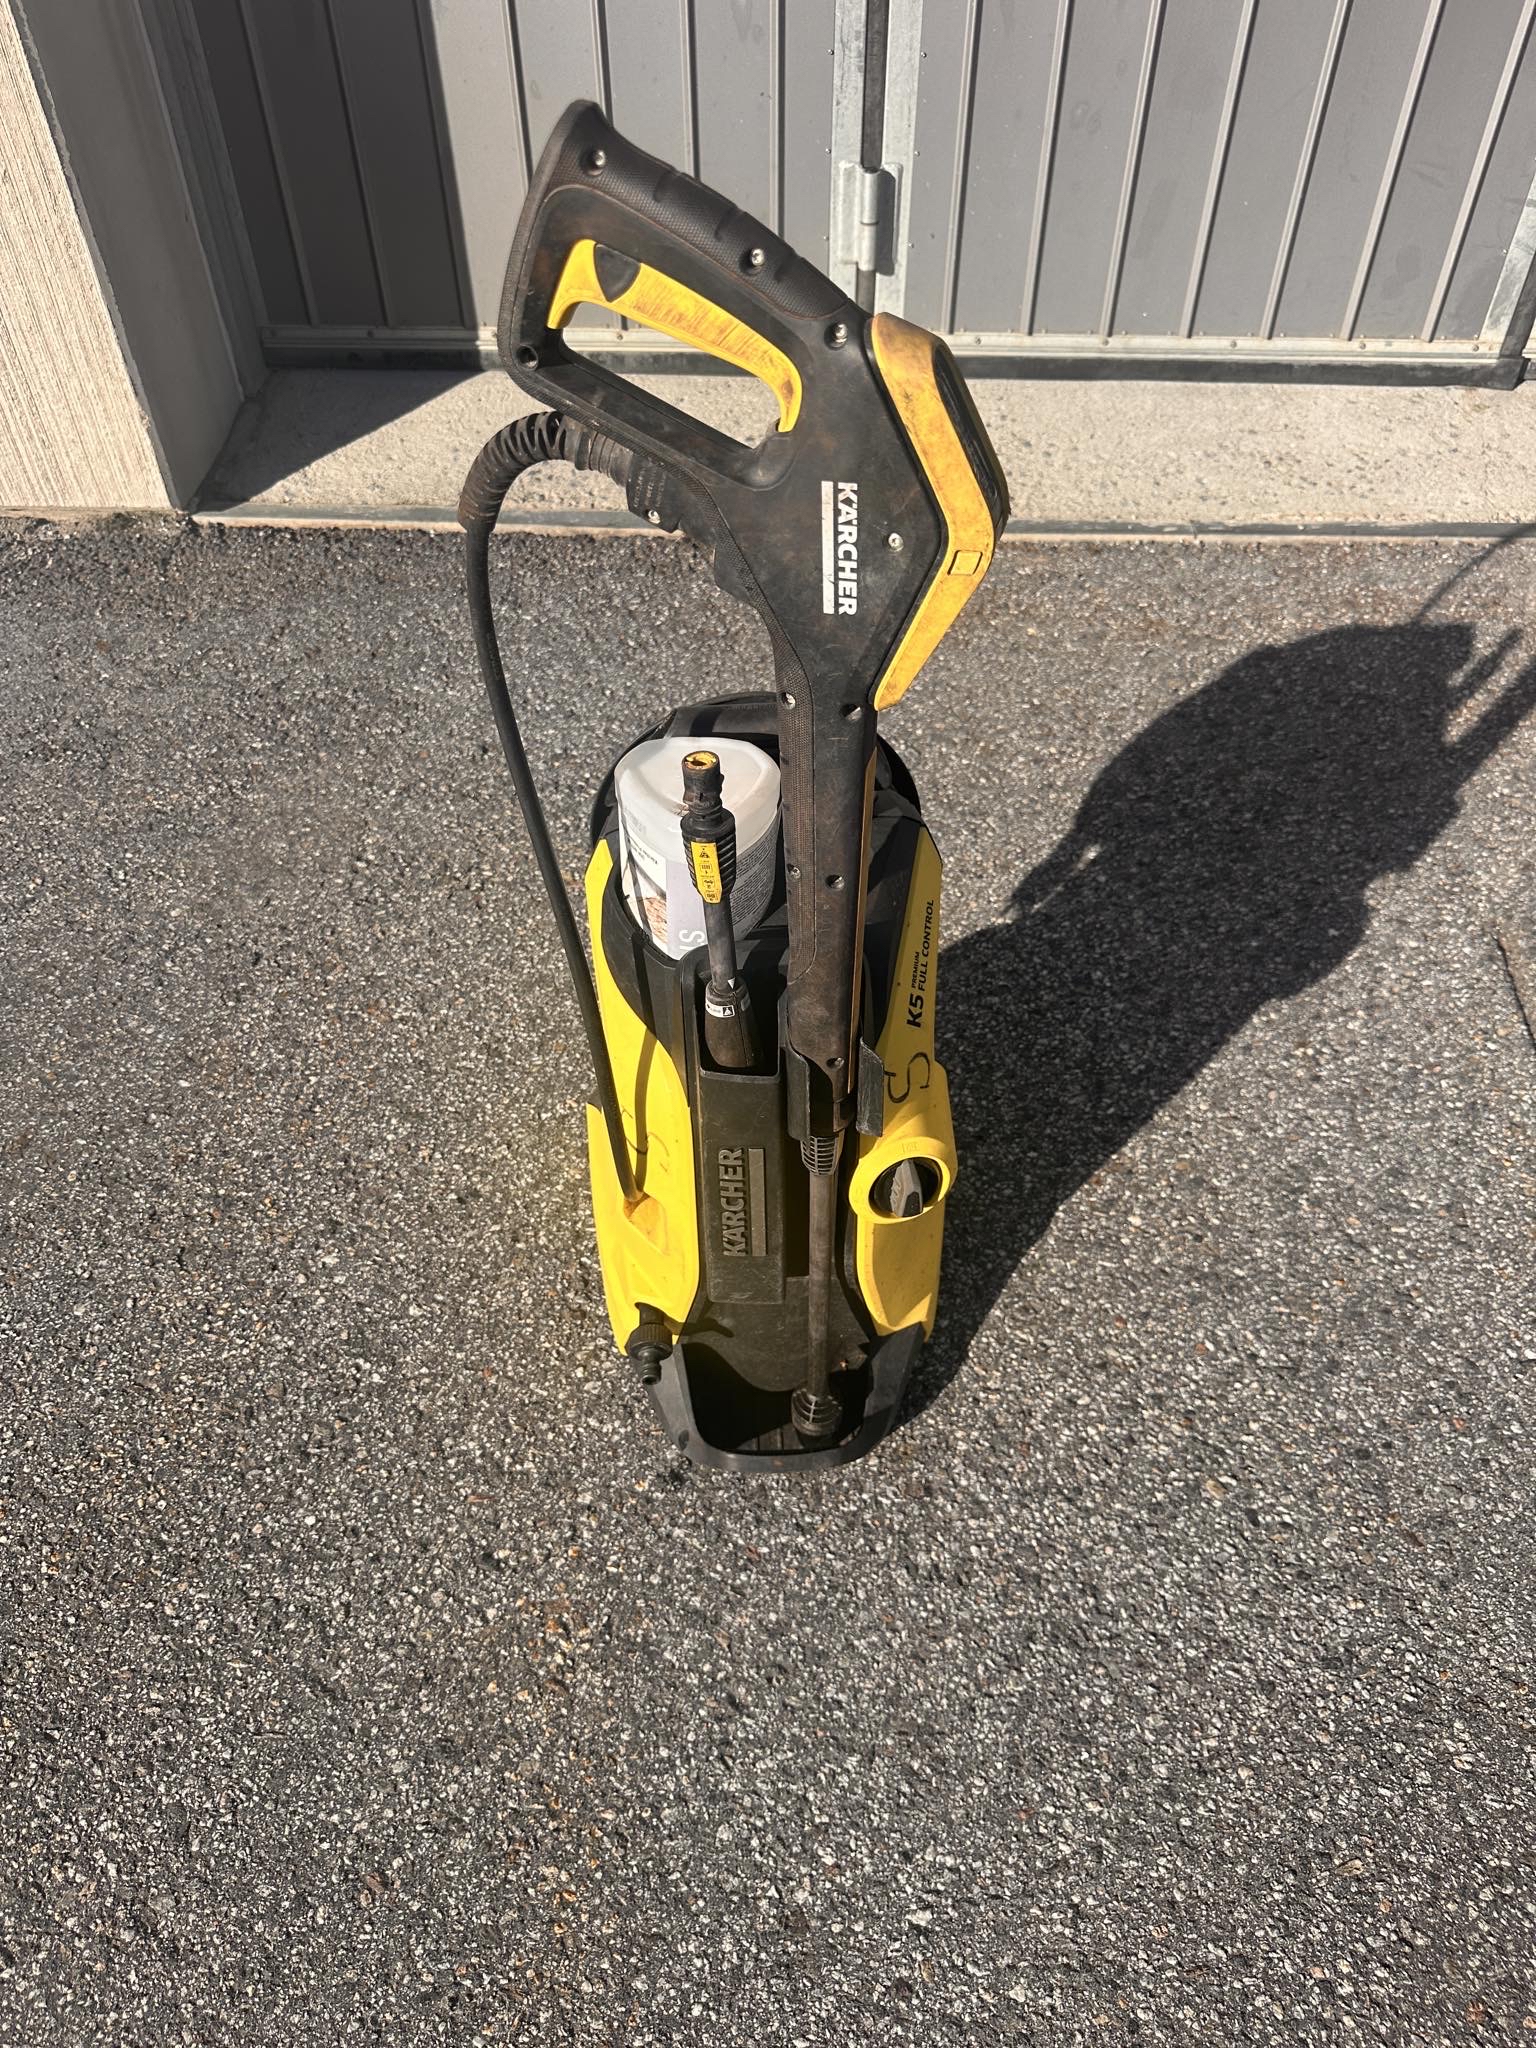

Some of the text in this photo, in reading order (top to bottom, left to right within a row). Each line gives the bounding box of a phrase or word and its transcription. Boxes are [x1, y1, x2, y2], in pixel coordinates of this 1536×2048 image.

[837, 482, 858, 616] KÄRCHER
[911, 951, 920, 989] PREMIUM
[918, 899, 935, 991] FULL CONTROL
[906, 992, 925, 1028] K5
[718, 1147, 747, 1257] KÄRCHER
